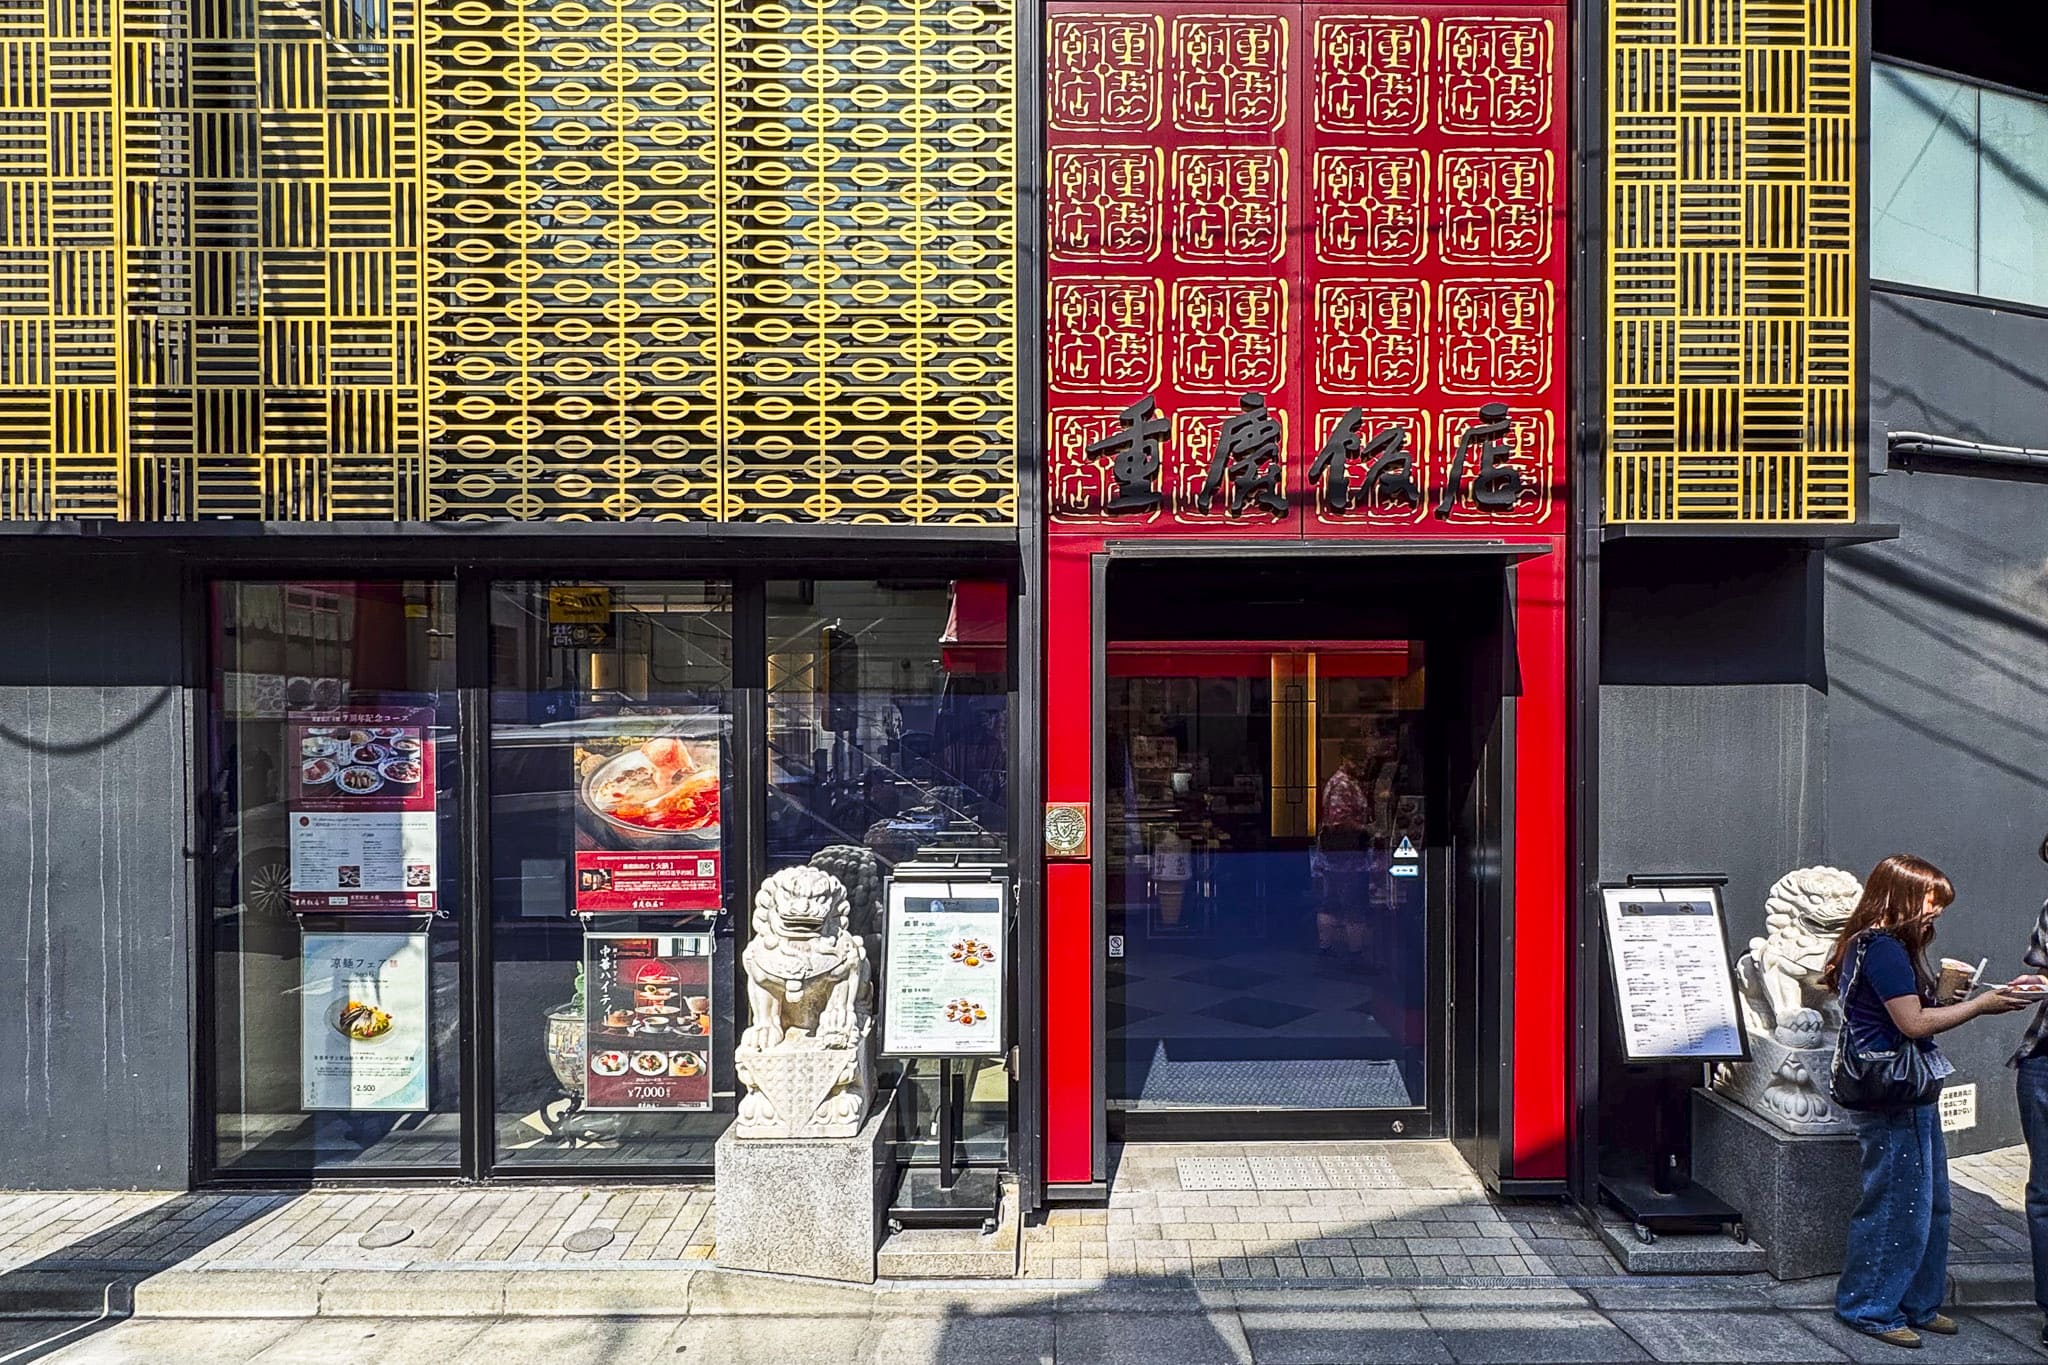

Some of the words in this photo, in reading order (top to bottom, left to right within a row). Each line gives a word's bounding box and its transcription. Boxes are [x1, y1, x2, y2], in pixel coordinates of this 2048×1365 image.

[1087, 393, 1521, 519] 重慶飯店
[627, 1086, 665, 1099] ¥7,000
